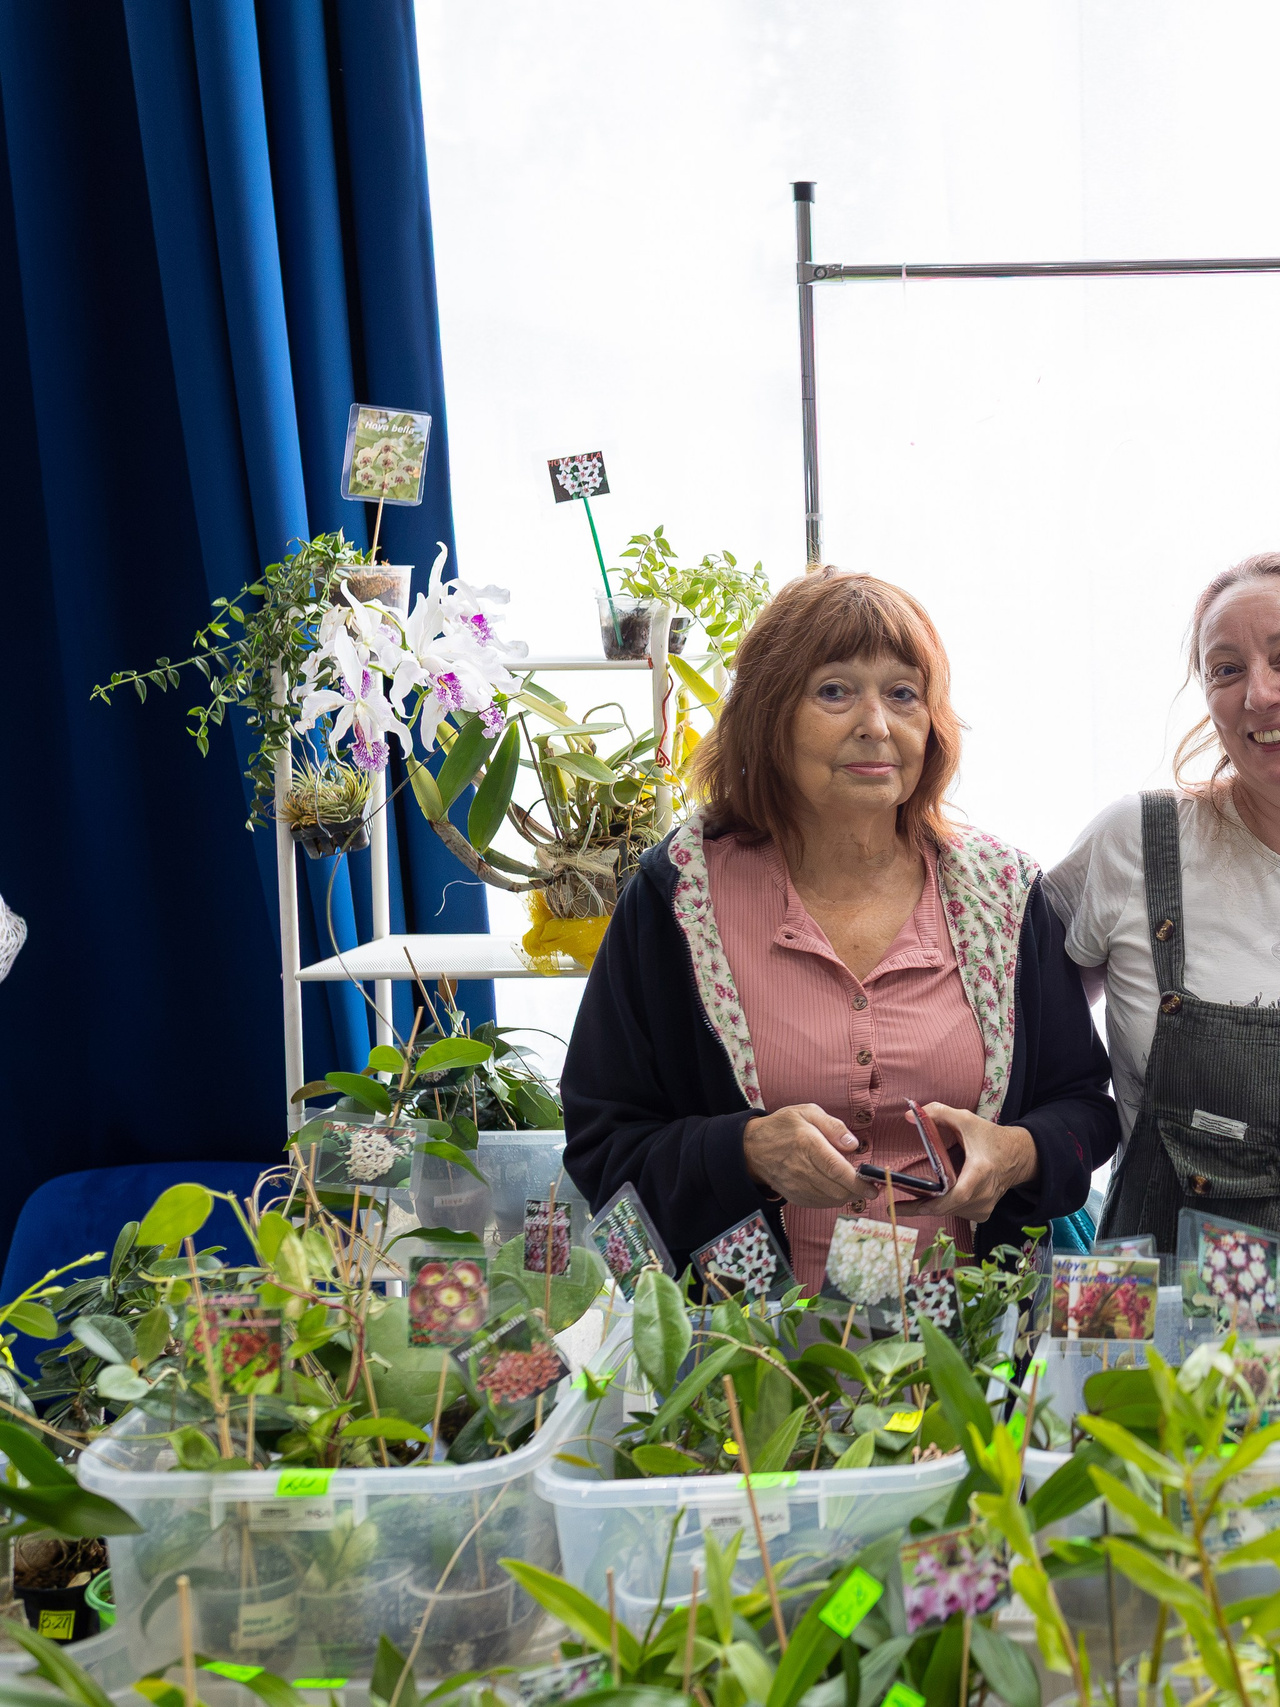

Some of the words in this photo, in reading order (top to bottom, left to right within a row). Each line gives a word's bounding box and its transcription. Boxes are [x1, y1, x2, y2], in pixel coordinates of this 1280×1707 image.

[364, 421, 389, 434] Hoya
[391, 424, 415, 435] bella
[1056, 1260, 1088, 1272] Hoya
[457, 1340, 488, 1363] Hoya
[486, 1313, 528, 1344] gracilis
